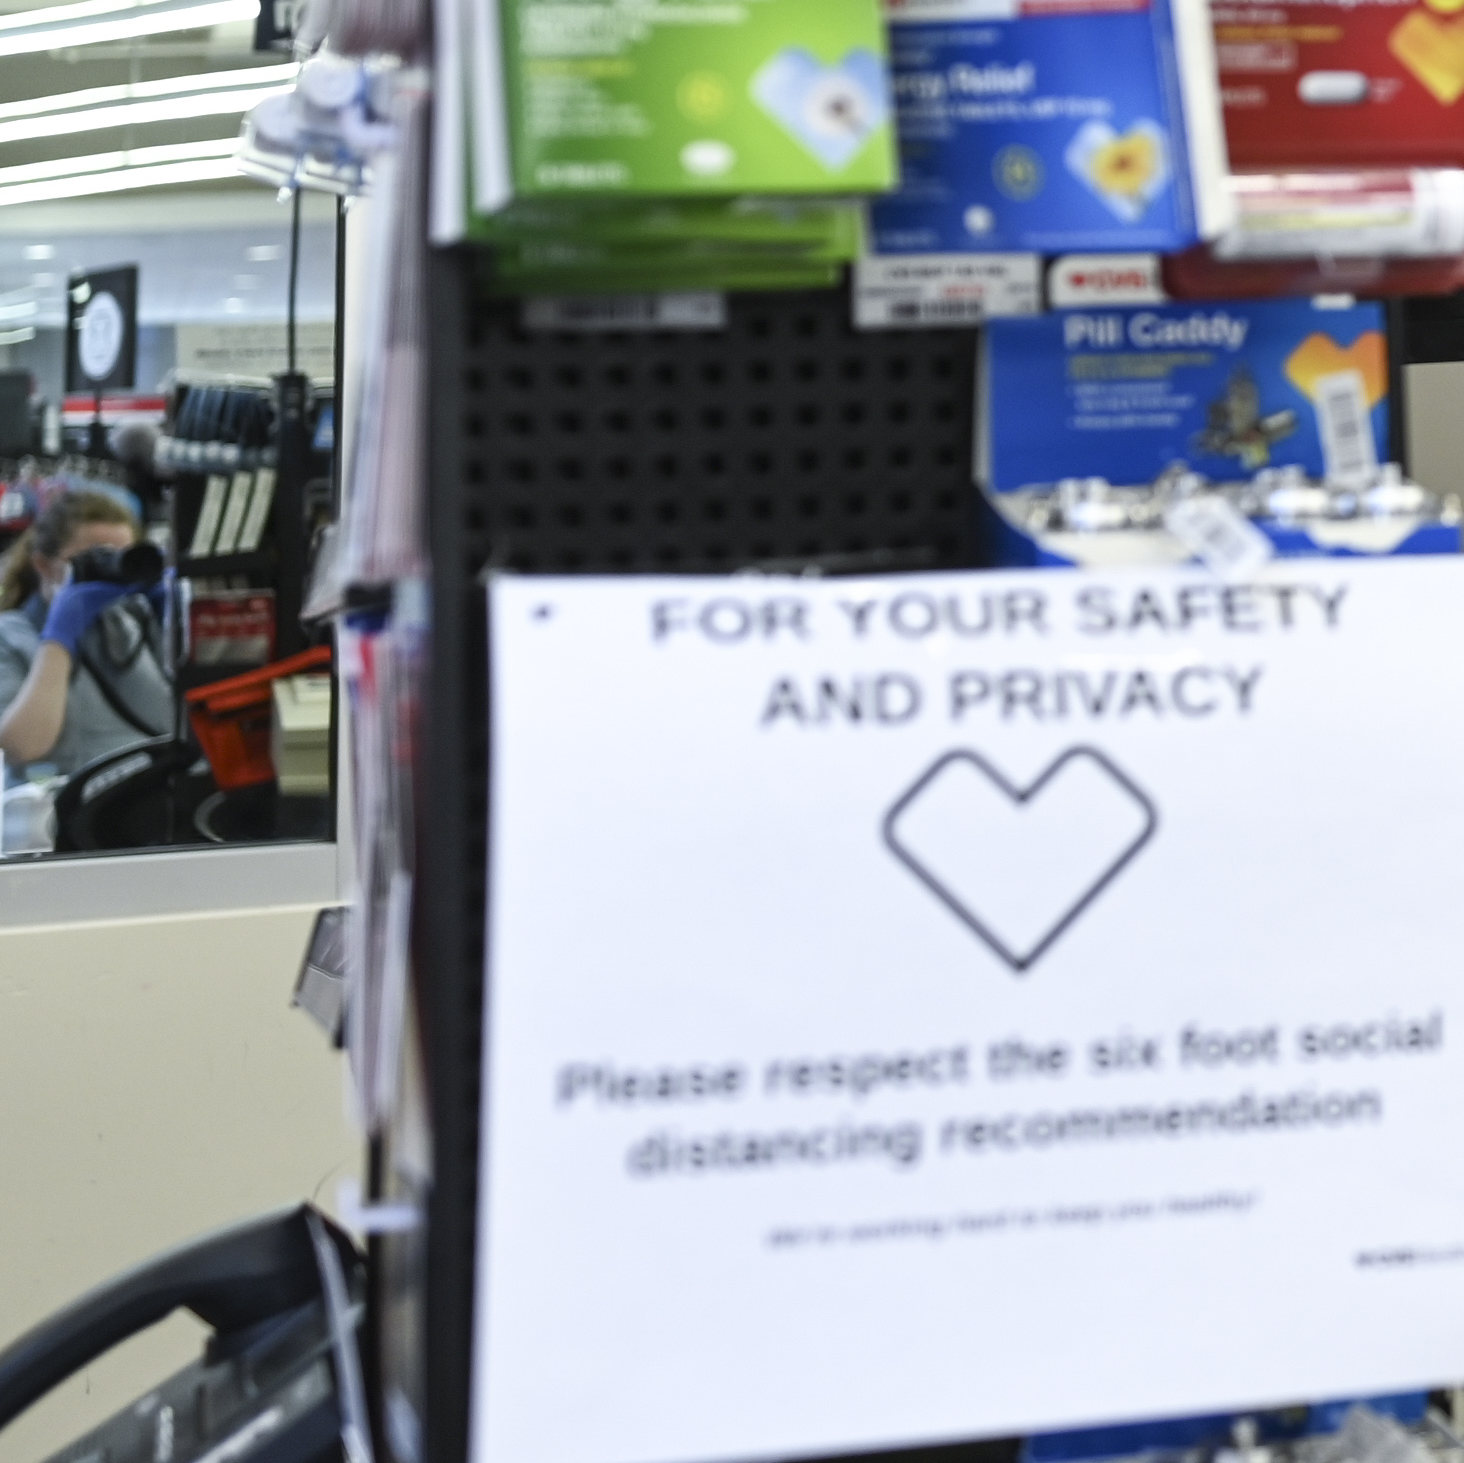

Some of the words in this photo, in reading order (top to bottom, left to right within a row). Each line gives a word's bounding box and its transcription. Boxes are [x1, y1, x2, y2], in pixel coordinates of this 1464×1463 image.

[1064, 315, 1118, 347] Pill
[1129, 313, 1247, 349] Caddy
[651, 595, 808, 643] FOR
[836, 588, 1047, 639] YOUR
[1076, 581, 1349, 635] SAFETY
[761, 672, 921, 728] AND
[949, 664, 1263, 724] PRIVACY
[557, 1059, 746, 1111] Please
[765, 1046, 969, 1101] respect
[987, 1037, 1069, 1080] the
[1089, 1030, 1160, 1075] six
[1179, 1021, 1280, 1066] foot
[1298, 1011, 1442, 1060] social
[628, 1121, 922, 1181] distancing
[940, 1084, 1381, 1152] recommendation
